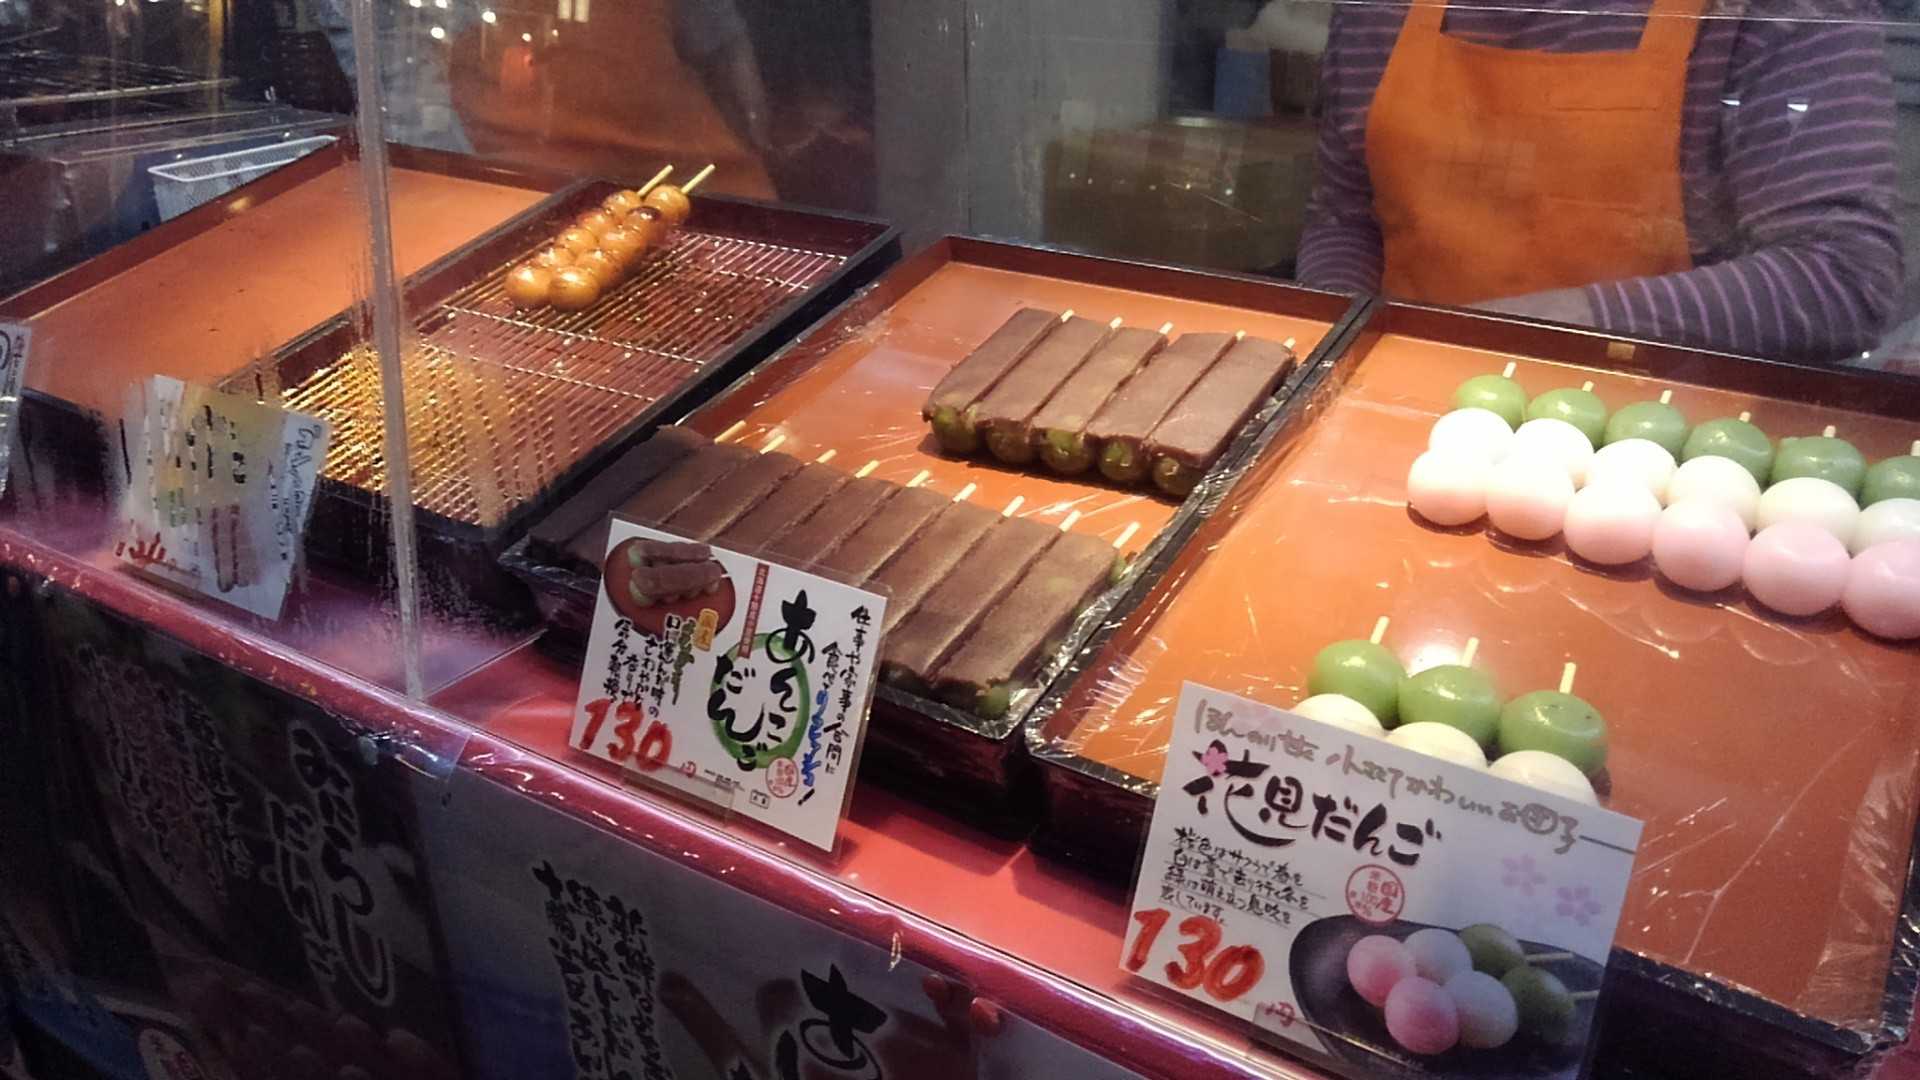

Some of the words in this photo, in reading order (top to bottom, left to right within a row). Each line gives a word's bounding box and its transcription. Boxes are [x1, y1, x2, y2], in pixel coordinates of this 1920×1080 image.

[707, 655, 768, 772] だんご
[765, 589, 816, 743] あんこ
[579, 698, 673, 773] 130
[1182, 738, 1442, 866] 花見だんご
[1133, 907, 1264, 1002] 130
